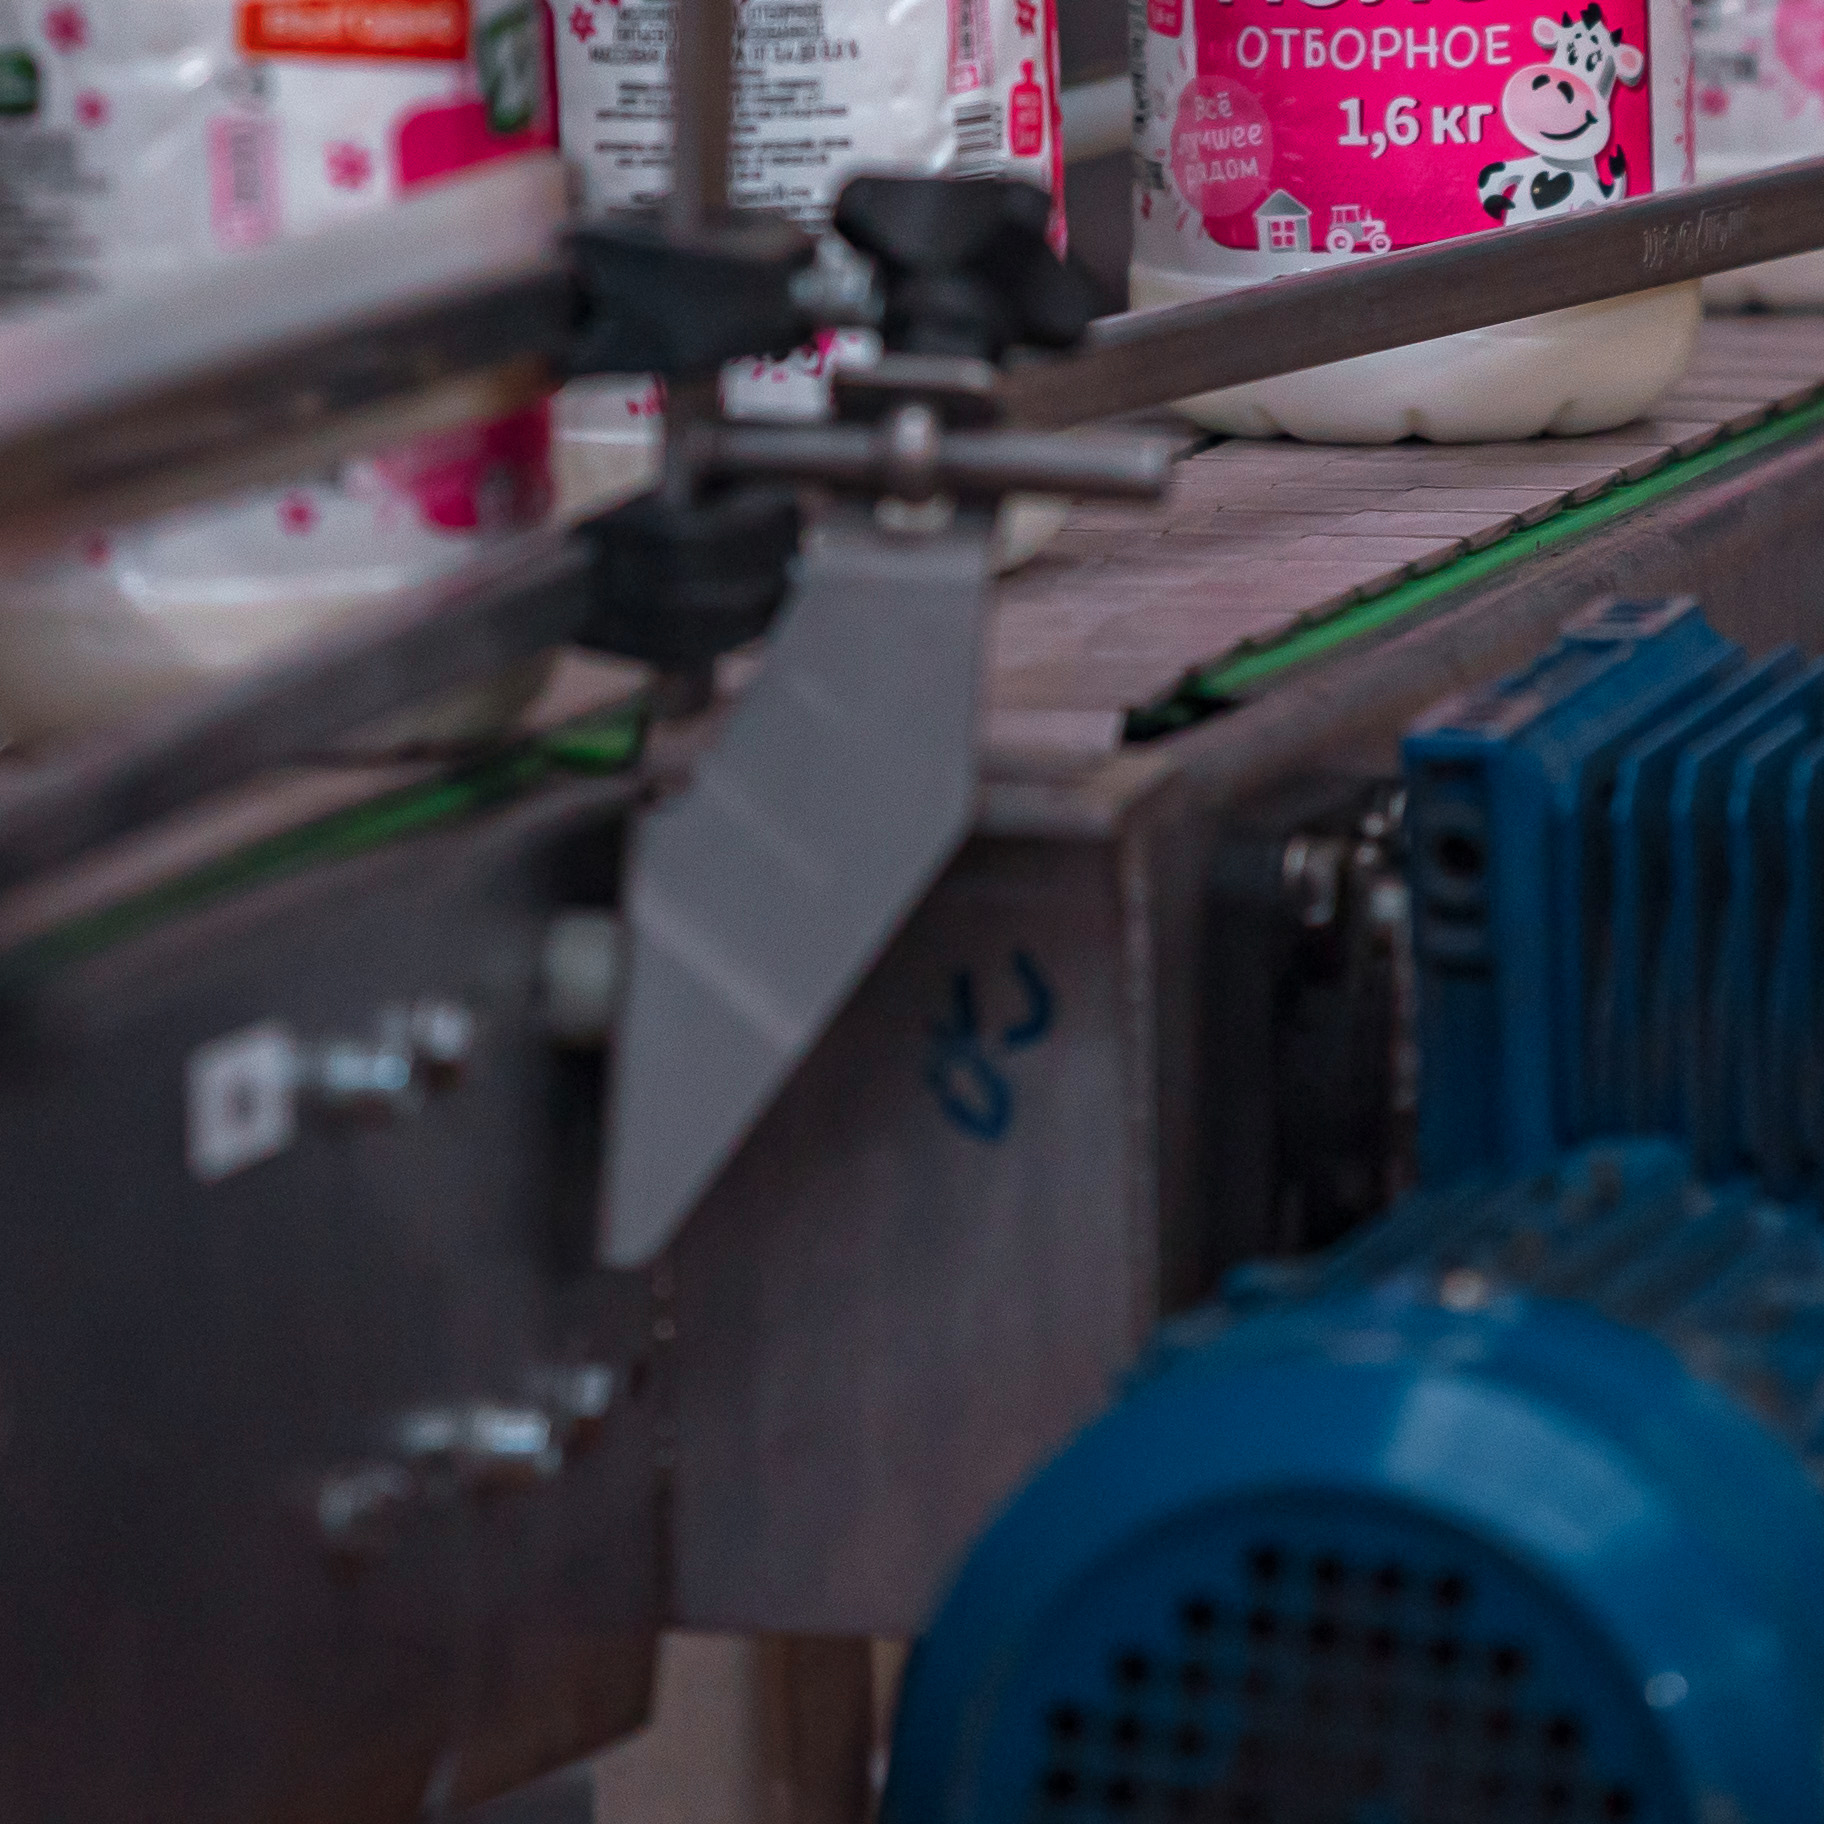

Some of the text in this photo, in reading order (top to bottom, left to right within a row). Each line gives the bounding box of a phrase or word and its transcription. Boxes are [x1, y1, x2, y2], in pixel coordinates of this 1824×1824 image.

[1236, 24, 1512, 72] ОТБОРНОЕ
[1337, 95, 1494, 158] 1,6 кг
